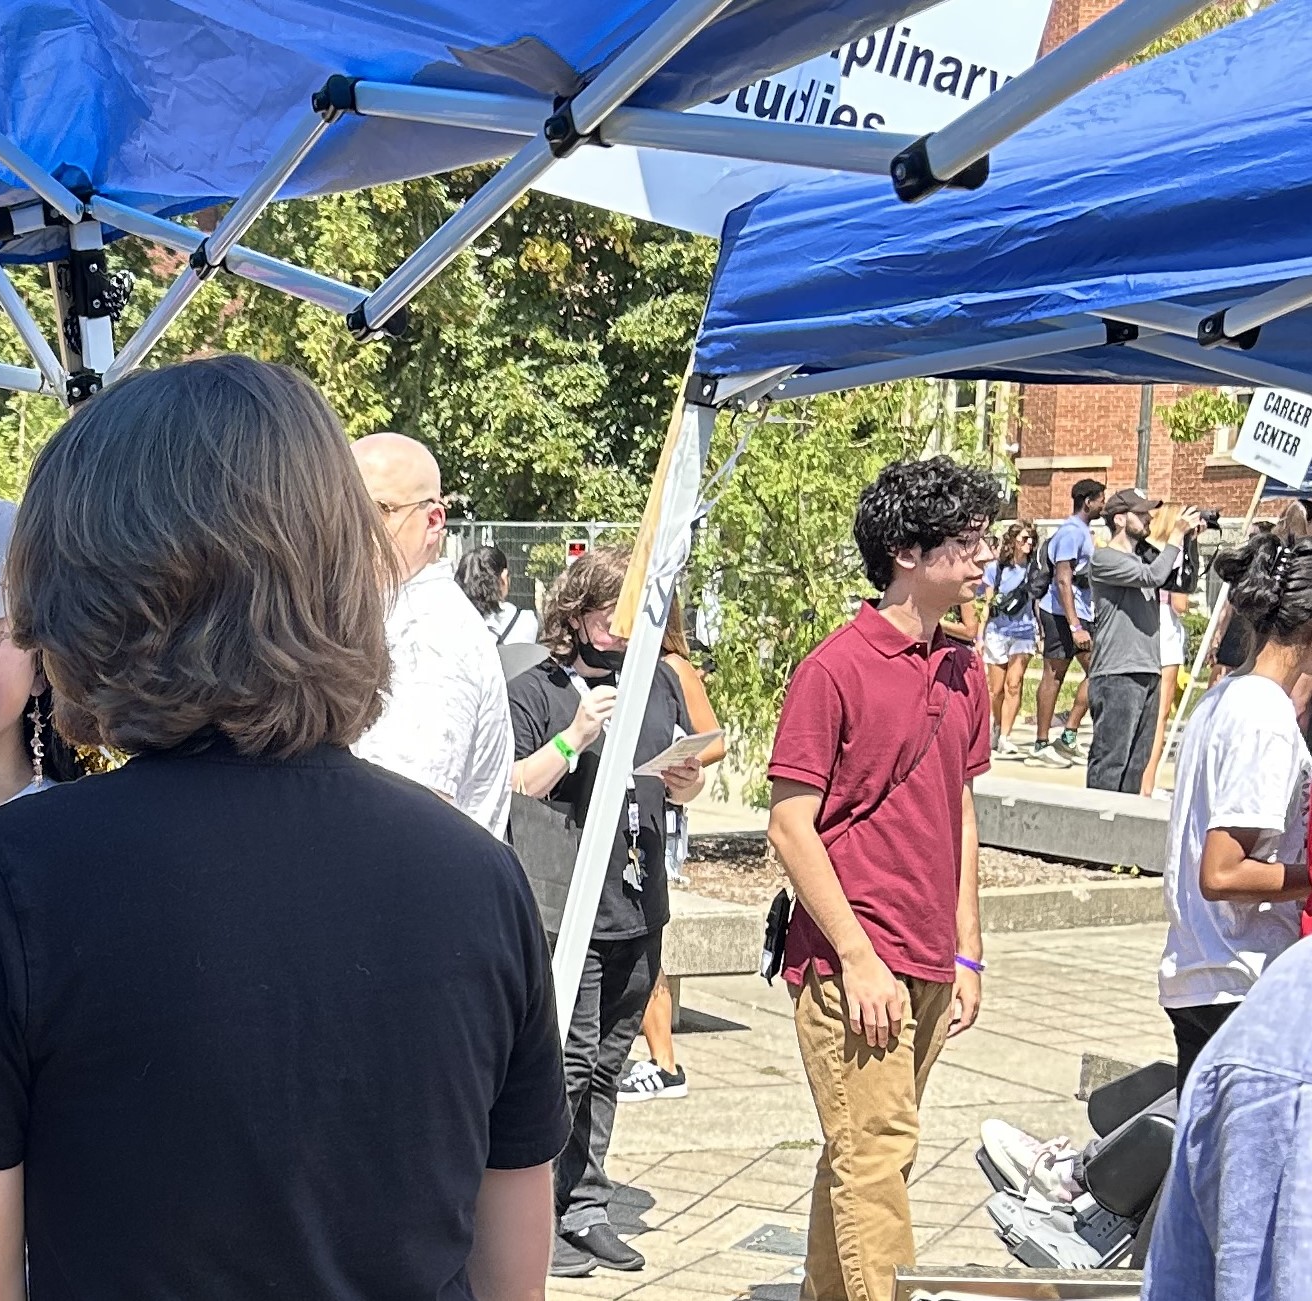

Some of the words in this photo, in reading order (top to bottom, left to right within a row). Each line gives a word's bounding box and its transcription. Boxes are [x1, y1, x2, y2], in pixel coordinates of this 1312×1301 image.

[708, 78, 886, 131] tudies
[1263, 391, 1312, 429] CAREER
[1252, 420, 1301, 457] CENTER
